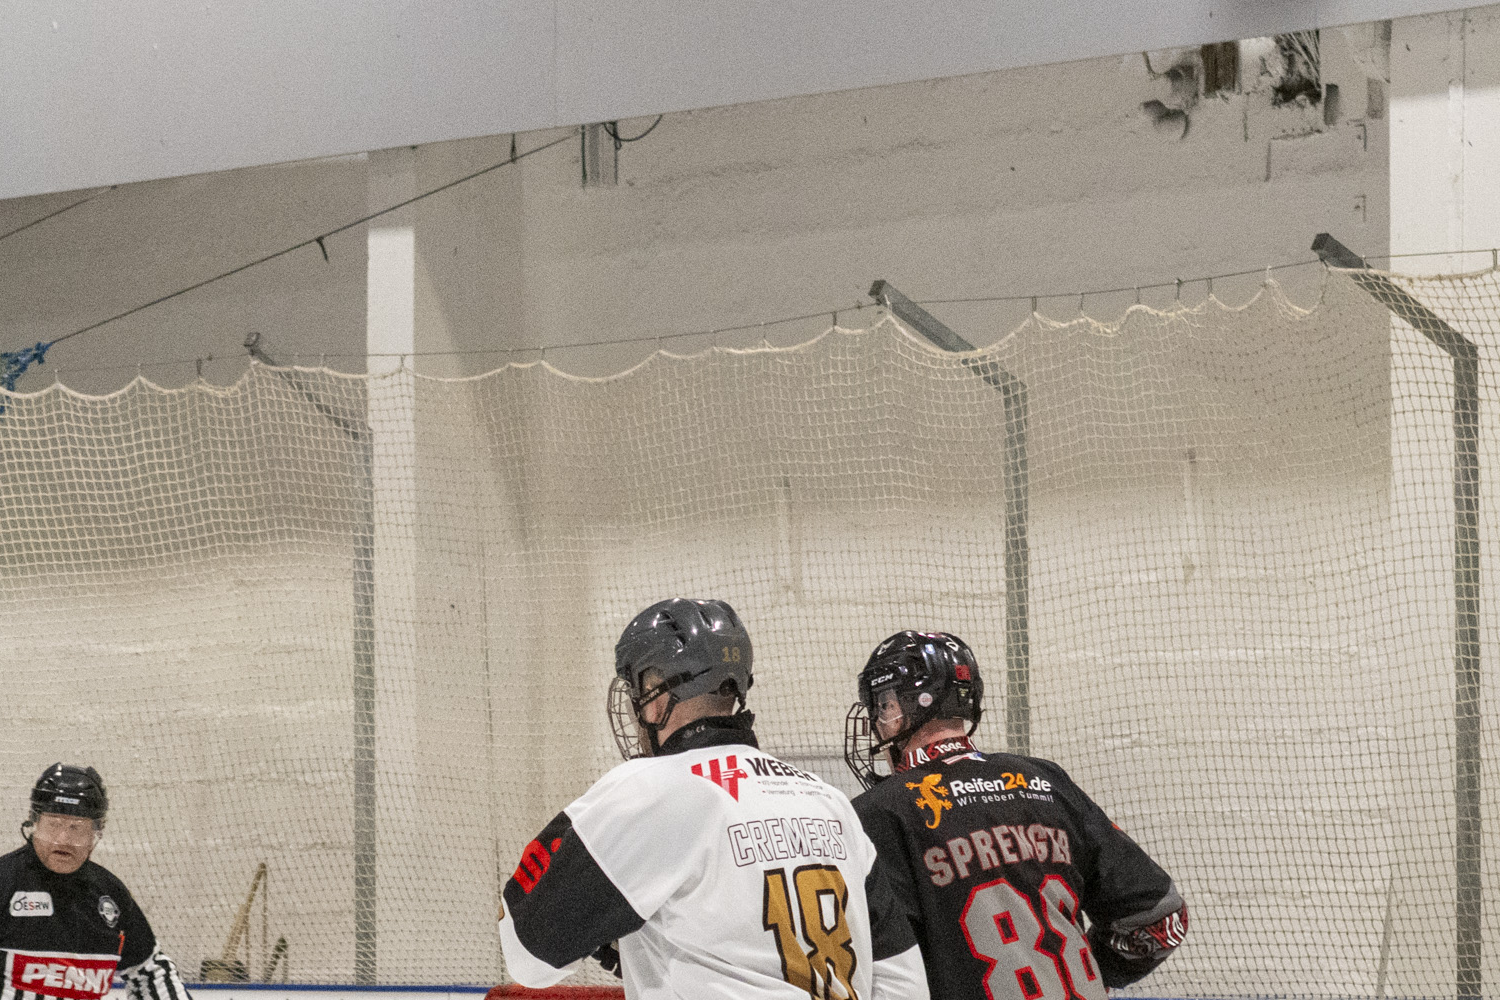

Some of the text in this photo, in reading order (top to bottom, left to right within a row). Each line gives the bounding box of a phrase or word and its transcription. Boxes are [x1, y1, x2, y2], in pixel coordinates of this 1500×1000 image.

[722, 647, 741, 663] 18
[871, 673, 894, 687] CCM
[950, 772, 1052, 797] Reifen24.de
[956, 796, 978, 807] Wir
[981, 793, 1015, 804] geben
[727, 817, 848, 868] CREMERS
[21, 962, 114, 994] PENNY
